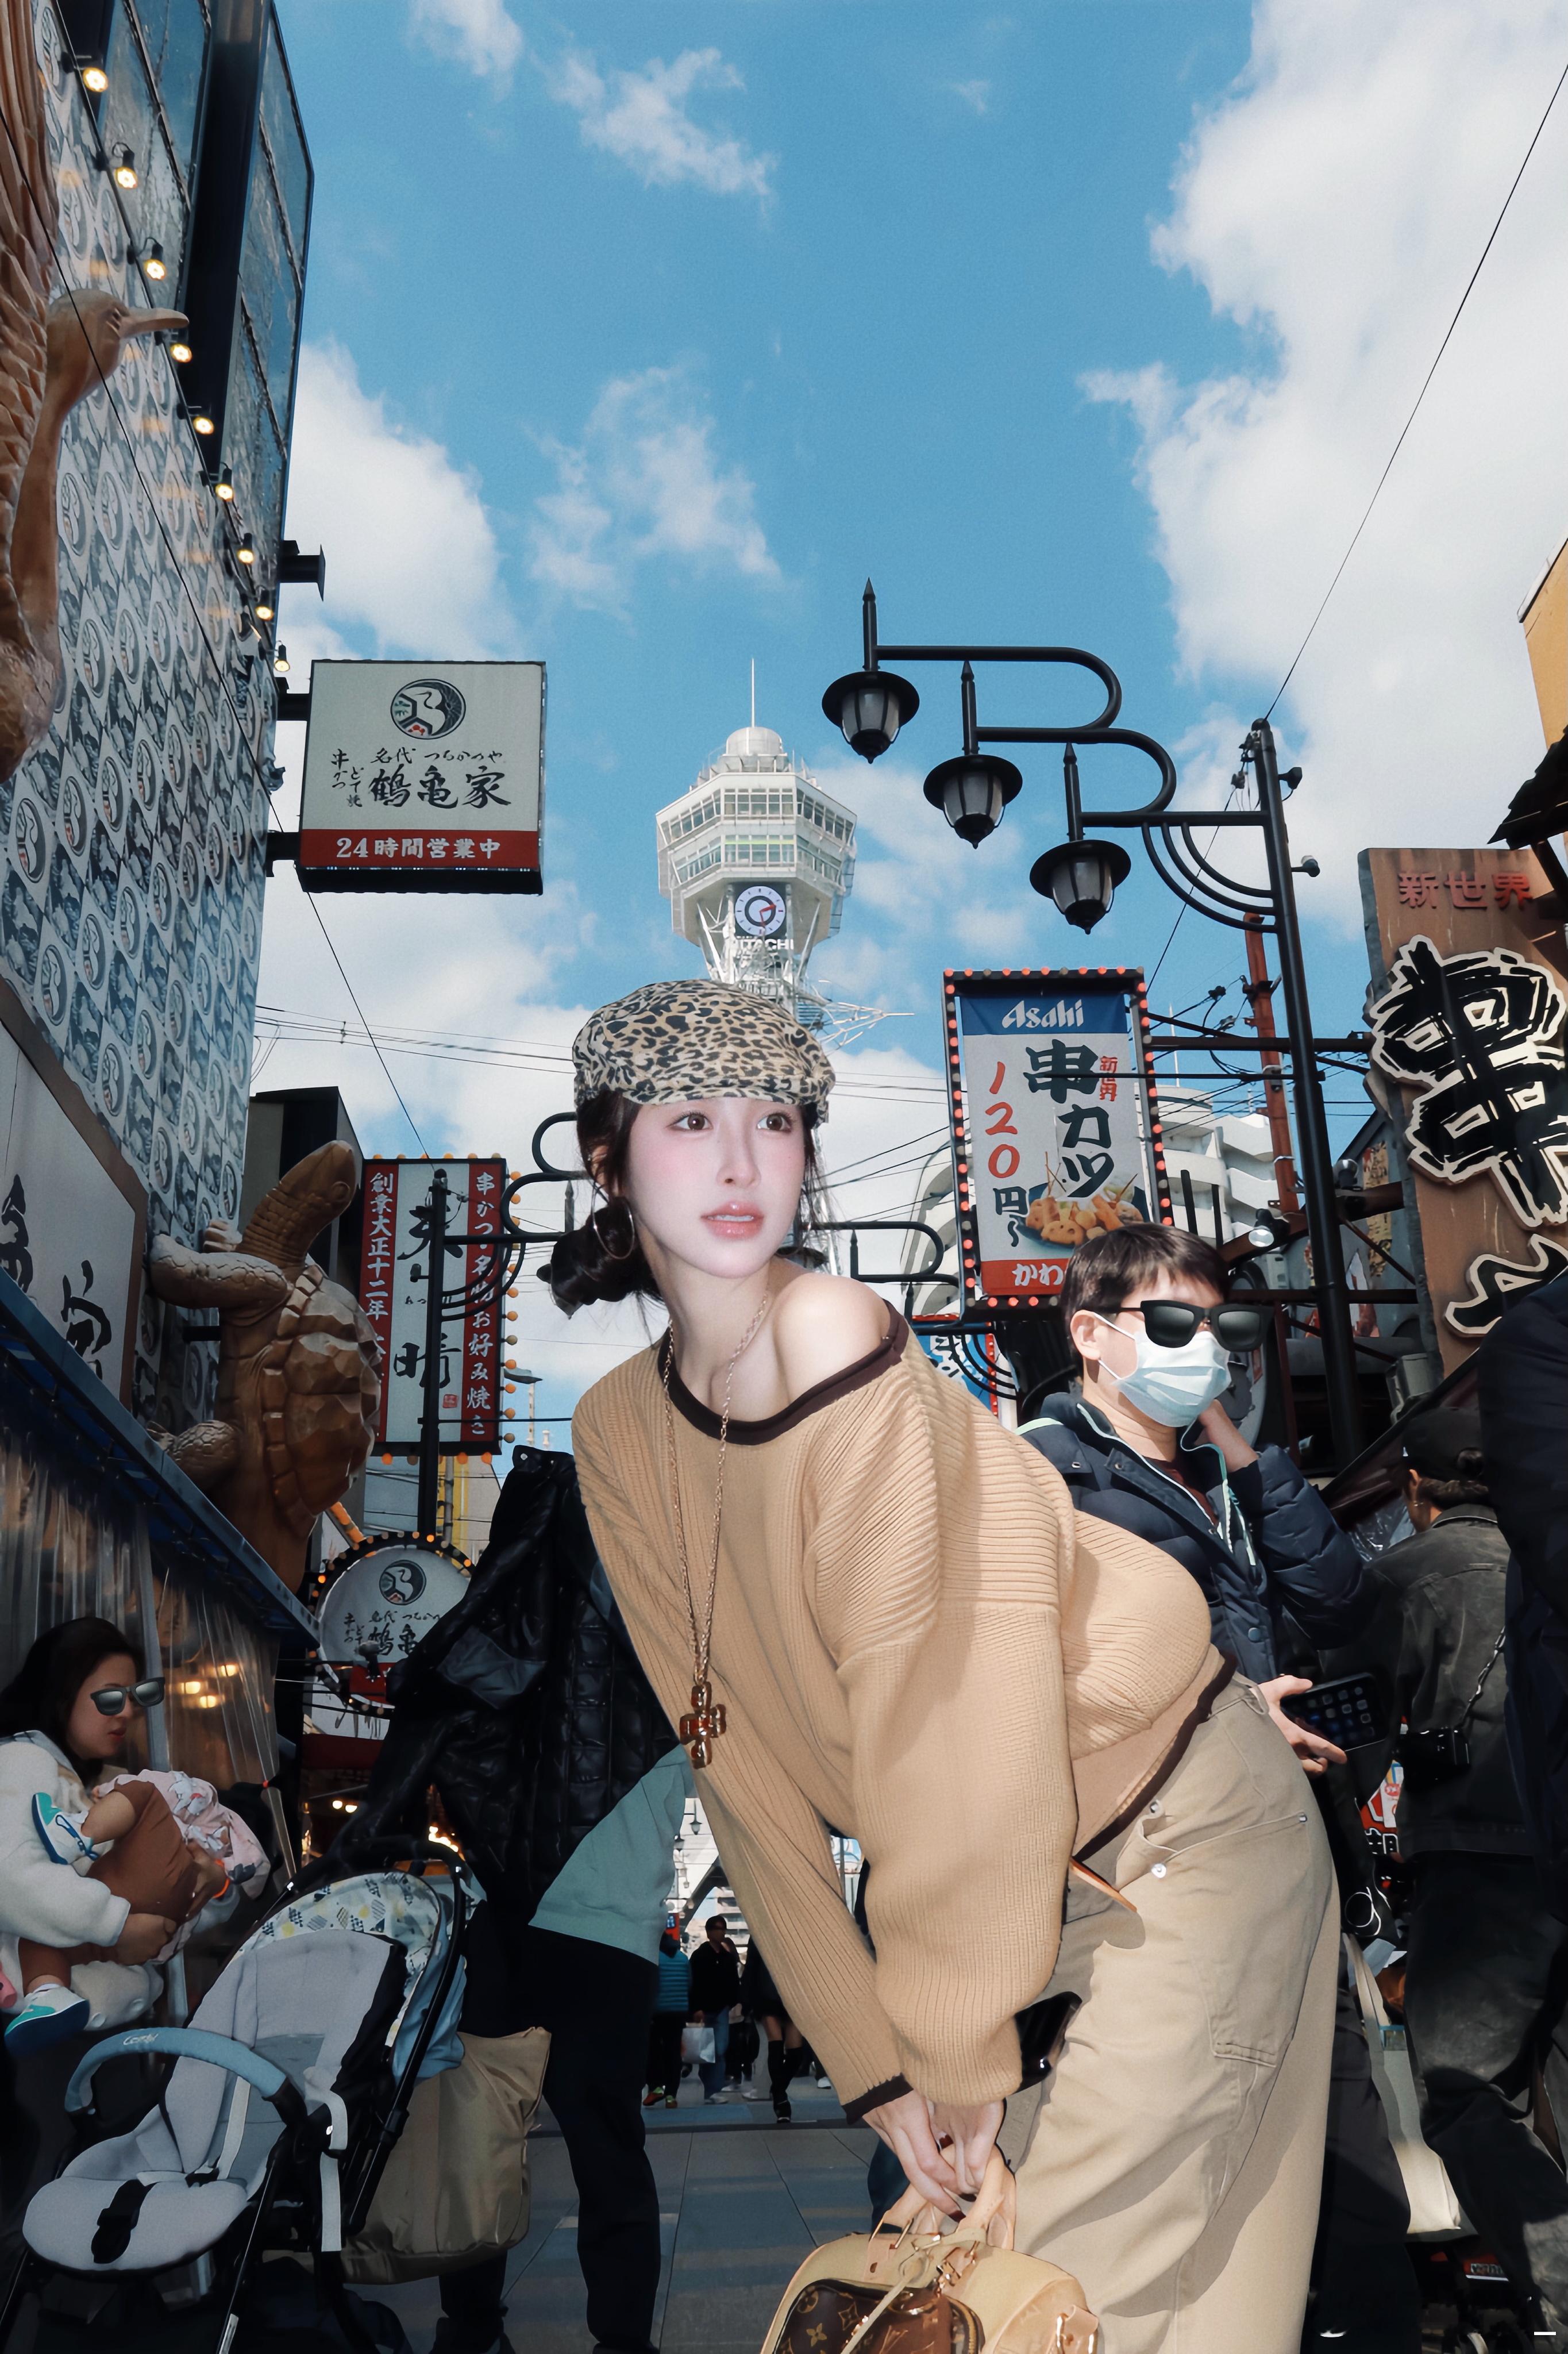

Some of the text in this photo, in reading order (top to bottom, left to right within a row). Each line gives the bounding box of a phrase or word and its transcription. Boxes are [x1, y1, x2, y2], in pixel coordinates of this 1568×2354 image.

[368, 763, 511, 809] 鶴亀家
[336, 837, 500, 859] 24時間営業中
[1398, 871, 1534, 910] 新世界
[1002, 999, 1084, 1029] Asahi
[1023, 1038, 1114, 1198] 串カツ
